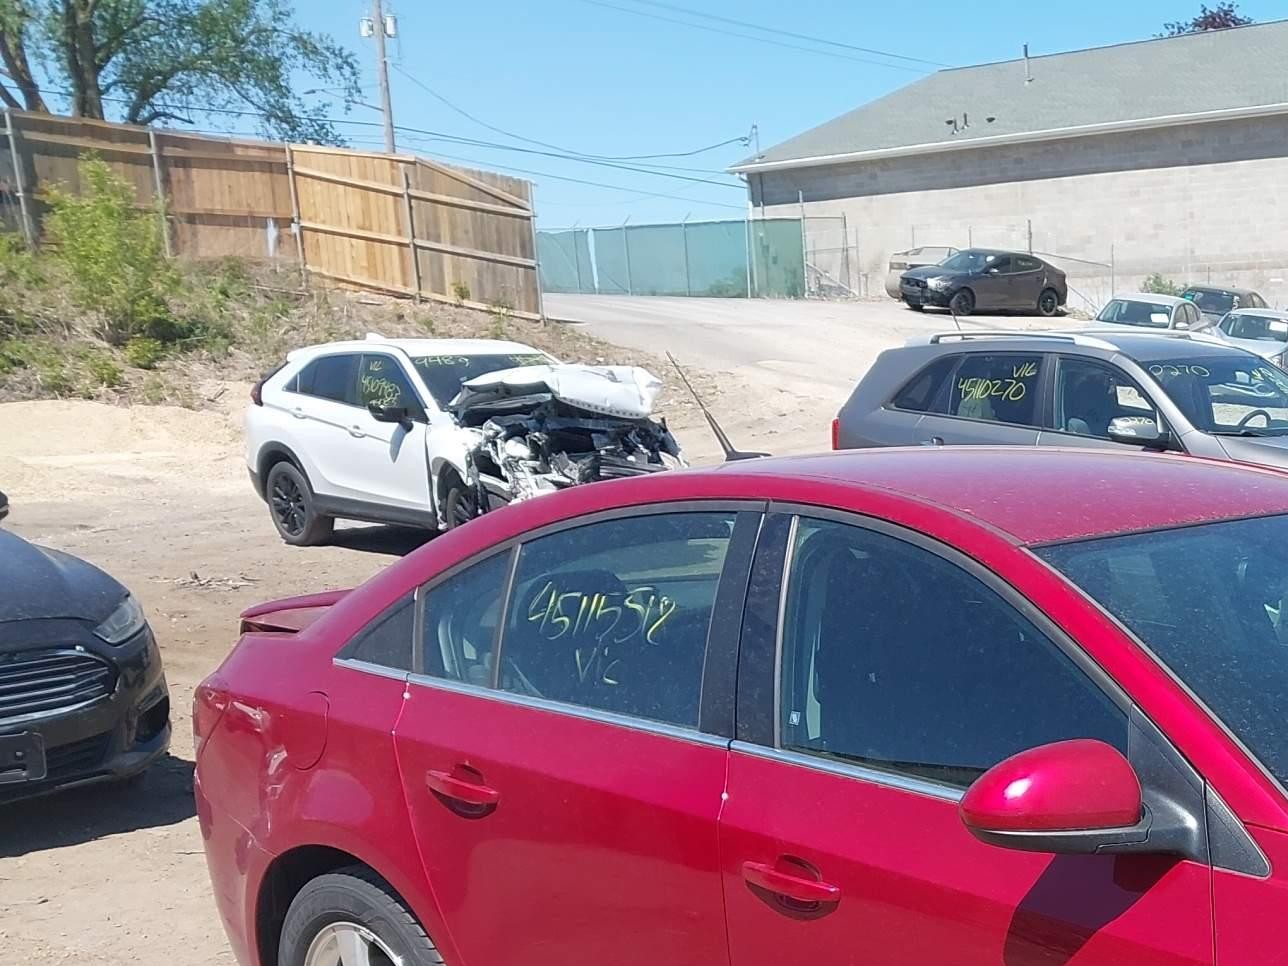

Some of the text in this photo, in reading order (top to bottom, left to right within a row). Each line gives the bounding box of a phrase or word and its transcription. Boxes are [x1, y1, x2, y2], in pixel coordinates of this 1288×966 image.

[1148, 364, 1211, 377] 0270
[957, 377, 1026, 402] 45110270
[527, 581, 676, 646] 45115518
